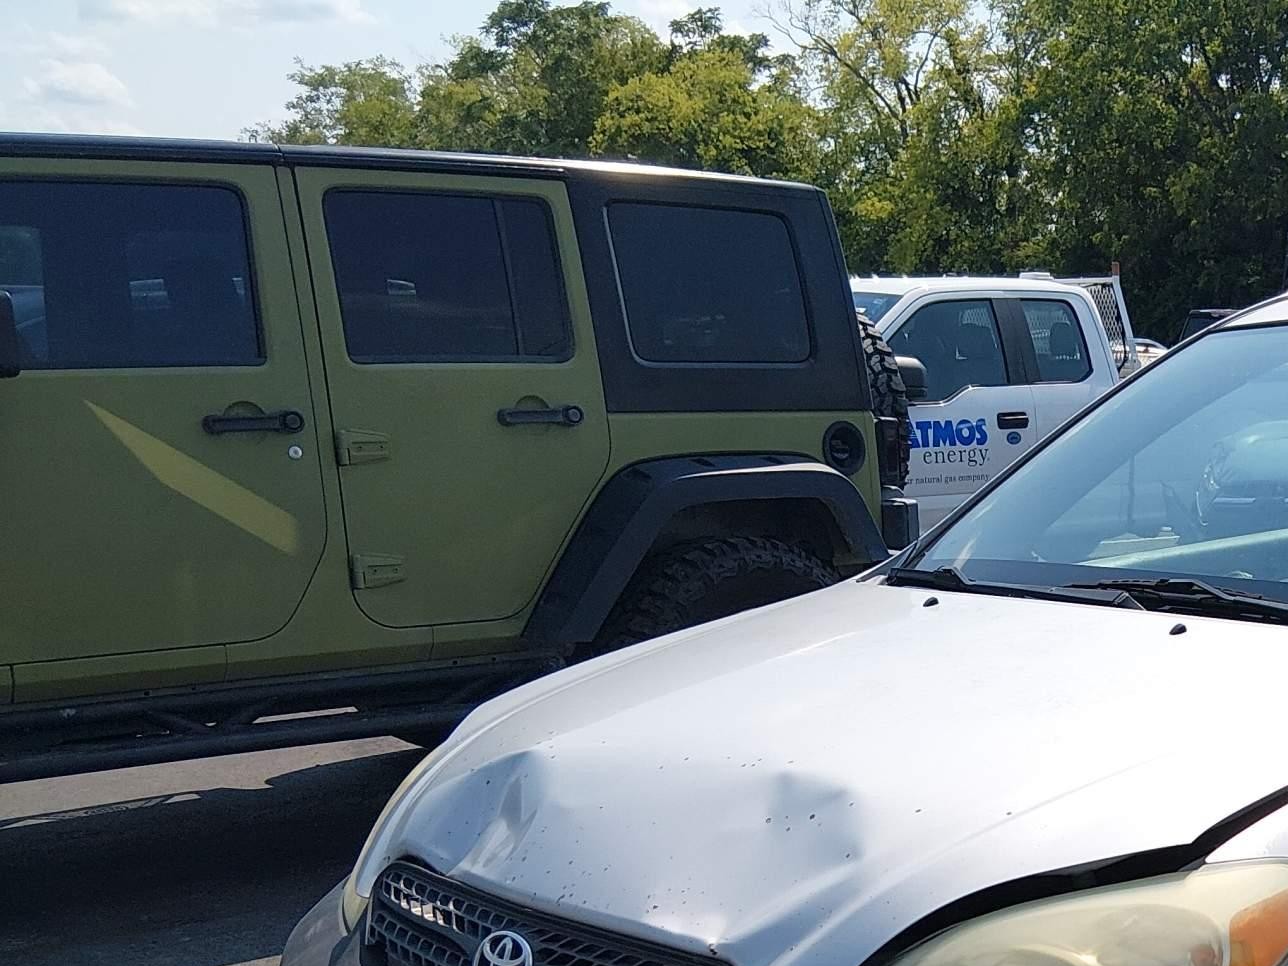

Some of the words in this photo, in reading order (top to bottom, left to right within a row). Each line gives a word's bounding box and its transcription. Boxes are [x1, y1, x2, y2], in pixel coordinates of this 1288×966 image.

[909, 418, 988, 448] ATMOS
[923, 448, 989, 467] energy
[915, 474, 942, 484] natural
[944, 476, 956, 484] gas
[958, 474, 989, 483] company
